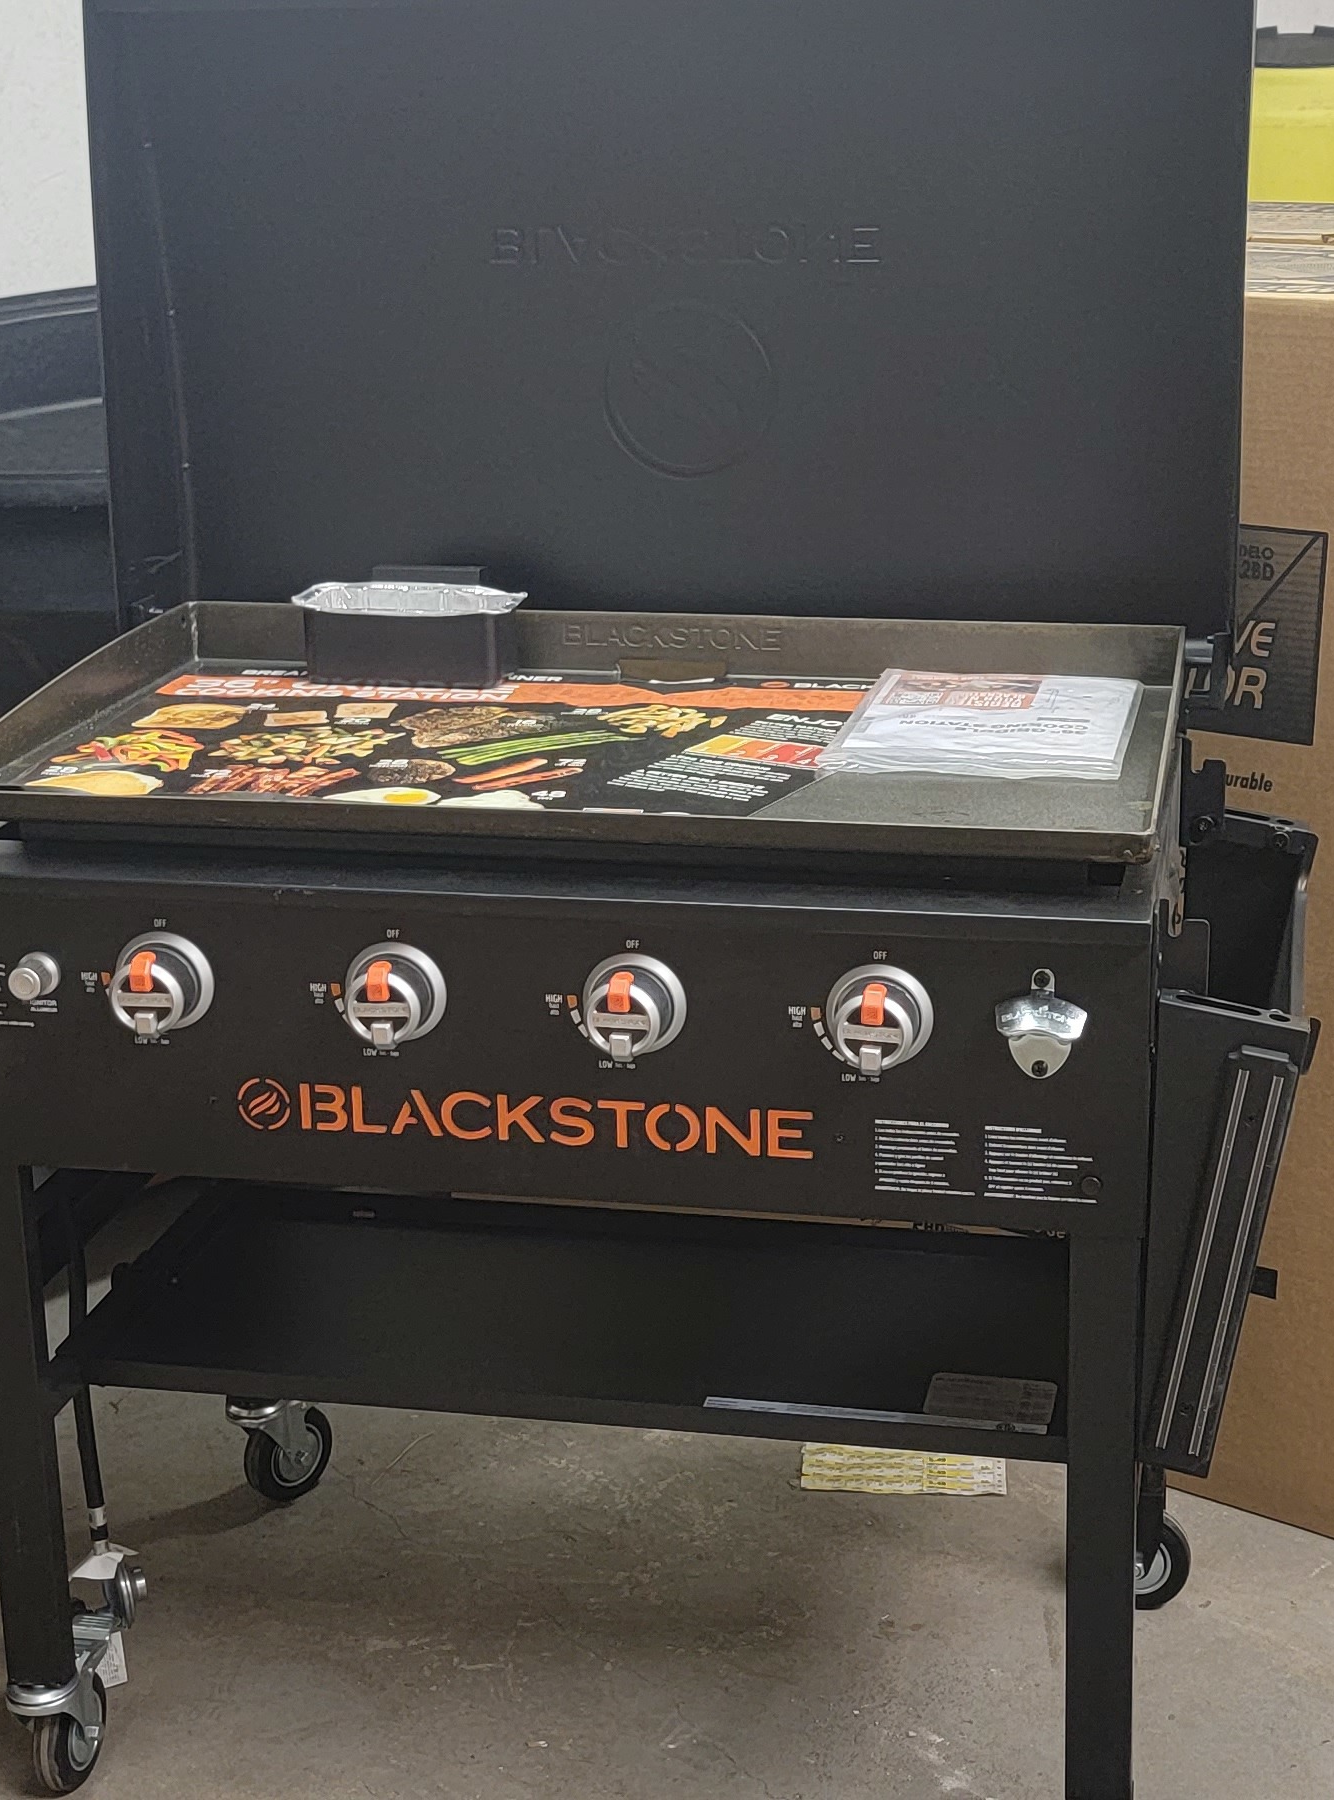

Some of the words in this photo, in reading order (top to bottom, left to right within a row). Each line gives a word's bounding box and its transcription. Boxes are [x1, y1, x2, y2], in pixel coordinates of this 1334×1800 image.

[562, 624, 783, 651] BLACKSTONE
[173, 687, 344, 699] COOKING
[350, 690, 510, 702] STATION
[765, 713, 847, 728] ENJO
[153, 918, 167, 928] OFF
[386, 929, 400, 938] OFF
[625, 939, 640, 949] OFF
[873, 950, 888, 960] OFF
[80, 971, 98, 981] HIGH
[309, 982, 327, 992] HIGH
[545, 994, 563, 1003] HIGH
[788, 1006, 807, 1016] HIGH
[363, 1047, 378, 1057] LOW
[598, 1060, 614, 1069] LOW
[841, 1073, 857, 1082] LOW
[299, 1082, 813, 1159] BLACKSTONE
